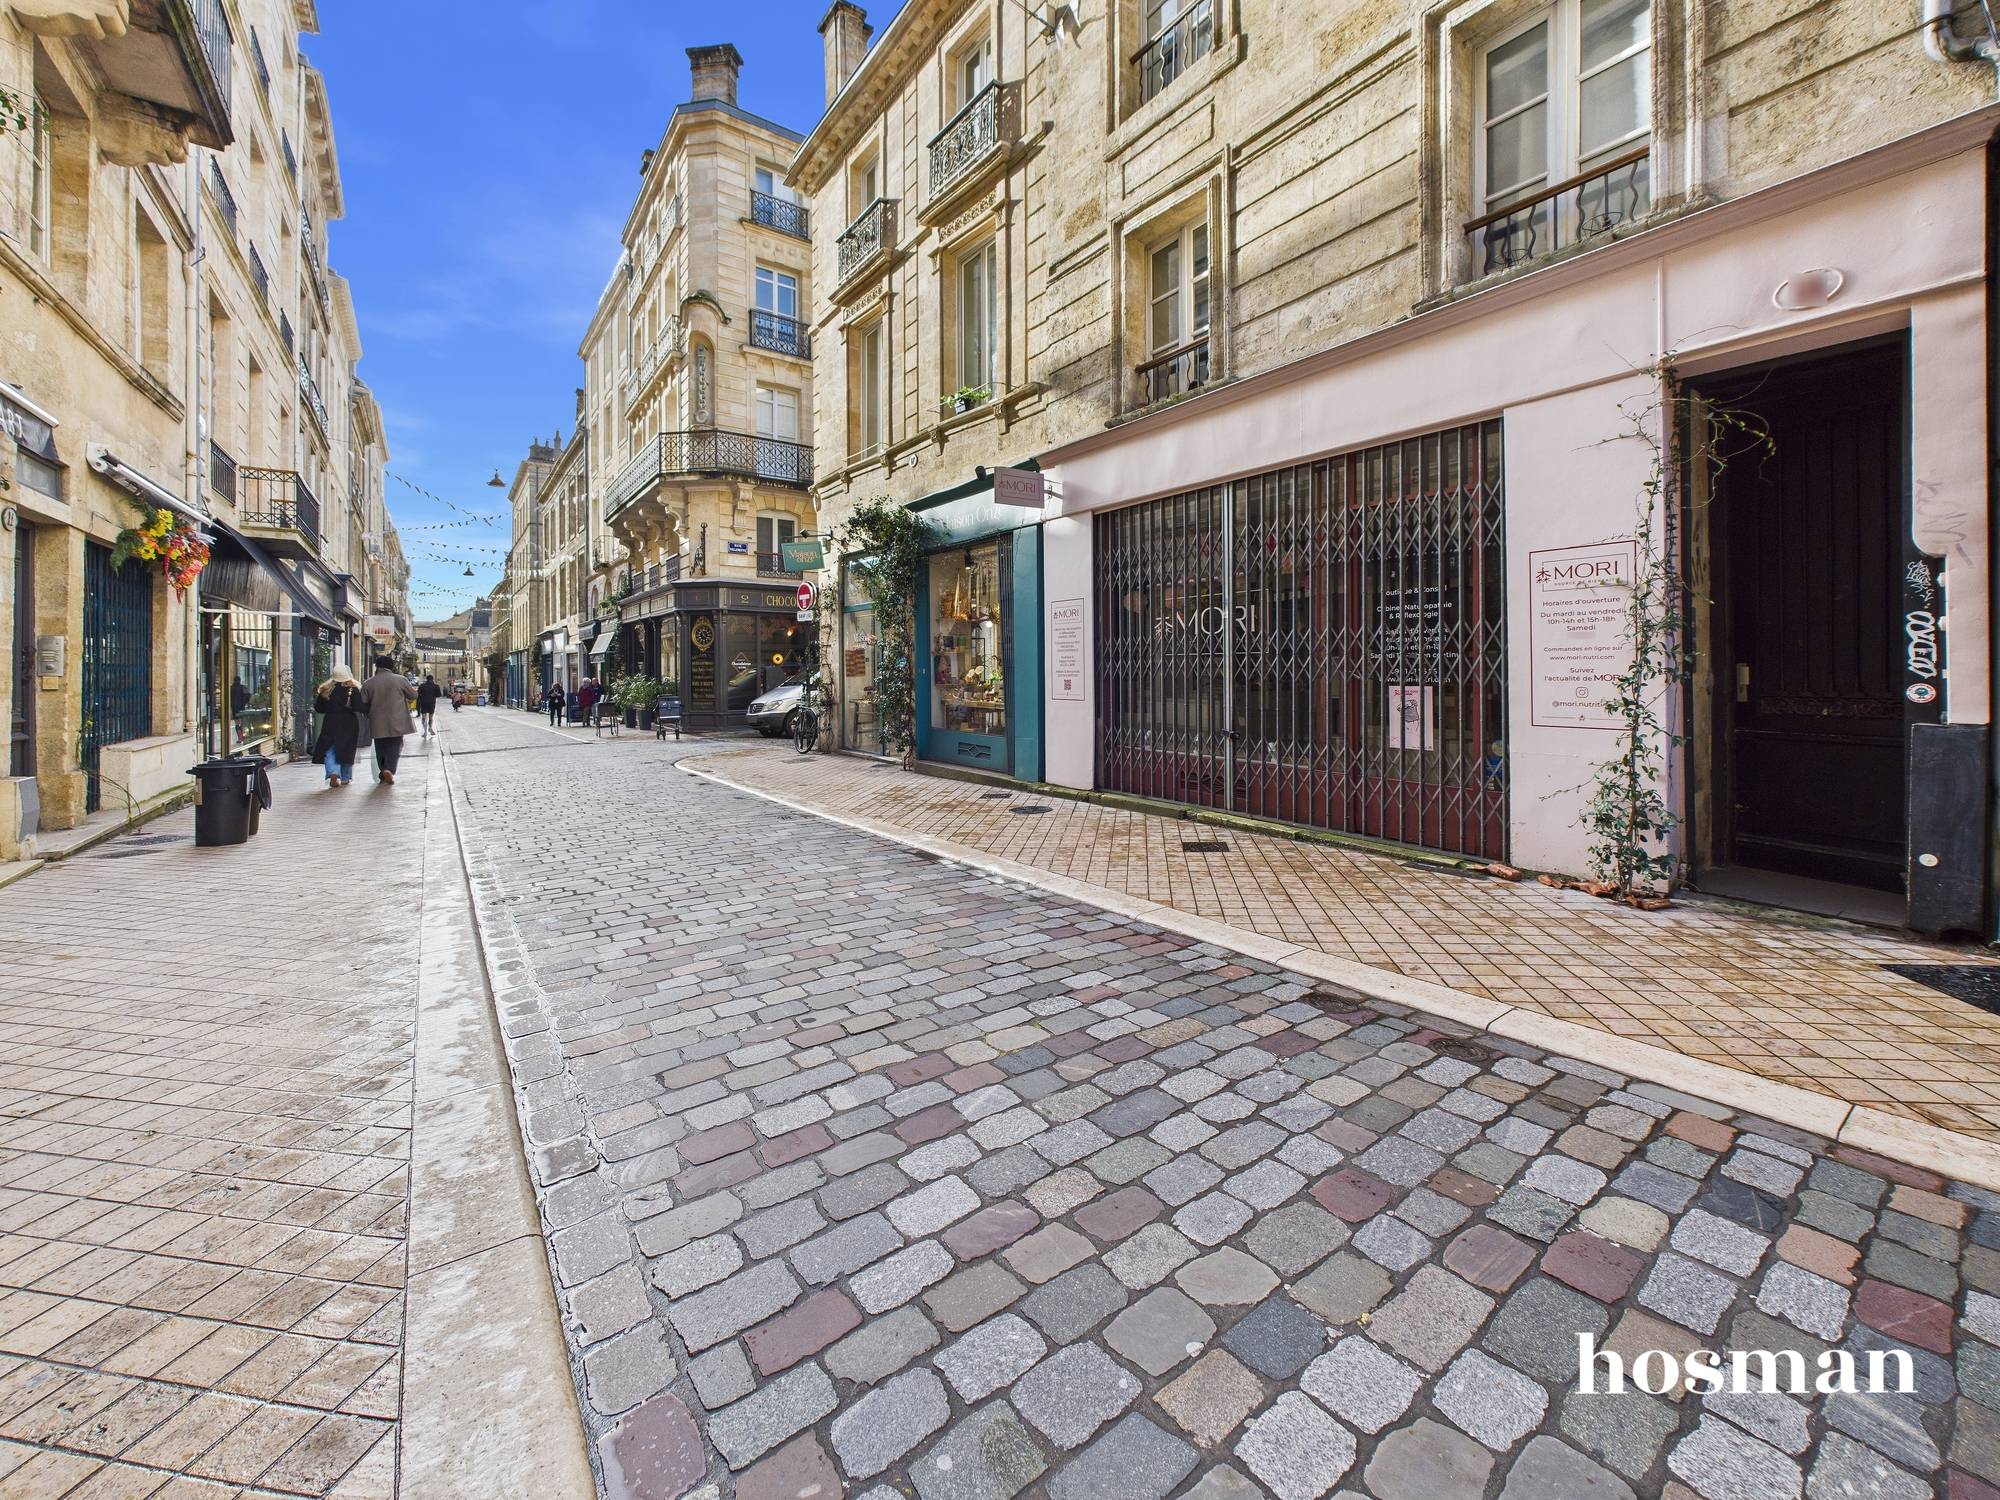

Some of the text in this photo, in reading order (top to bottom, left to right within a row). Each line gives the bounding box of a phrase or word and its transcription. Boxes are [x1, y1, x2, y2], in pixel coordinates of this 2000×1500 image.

[1005, 480, 1036, 494] MORI
[1554, 560, 1618, 580] MORI
[766, 595, 797, 607] CHOCO
[1542, 596, 1621, 607] Horaires d'ouverture
[1588, 607, 1624, 615] vendredi
[1593, 674, 1624, 682] MOR
